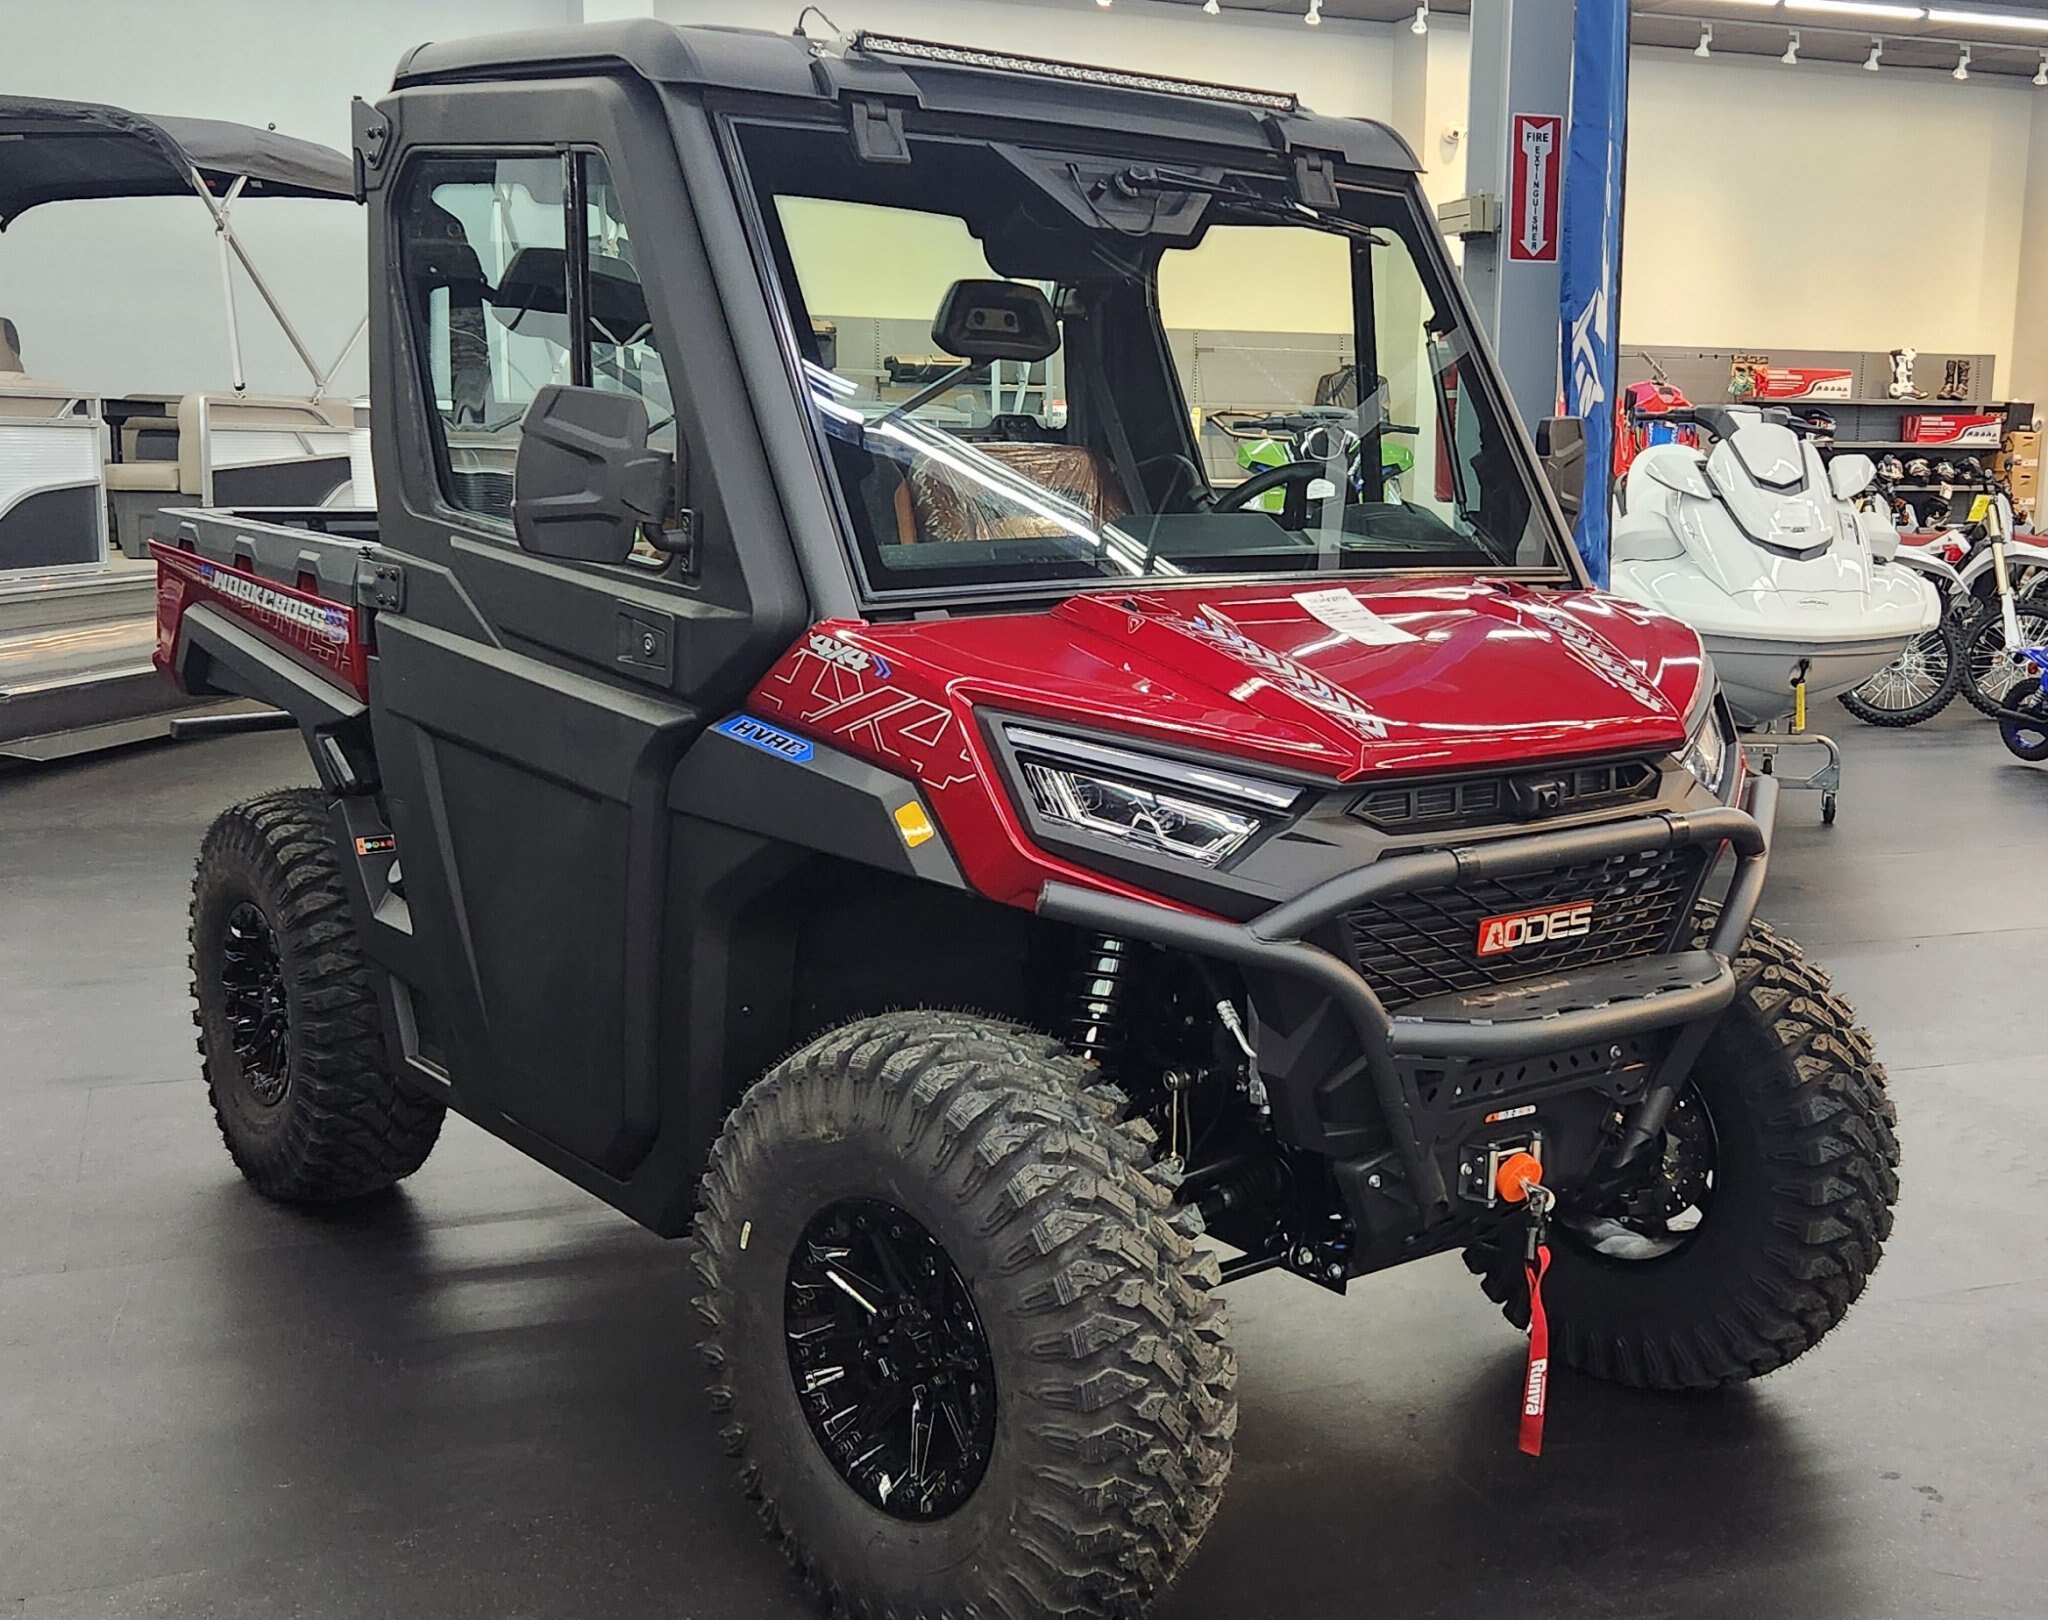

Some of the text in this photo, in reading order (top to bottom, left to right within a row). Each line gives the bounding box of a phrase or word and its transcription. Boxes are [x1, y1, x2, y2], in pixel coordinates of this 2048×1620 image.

[1526, 132, 1549, 142] FIRE
[1531, 145, 1541, 250] EXTINGUISHER
[731, 719, 806, 757] HVAC
[1482, 906, 1593, 952] AODES
[1525, 1358, 1547, 1416] Runva
